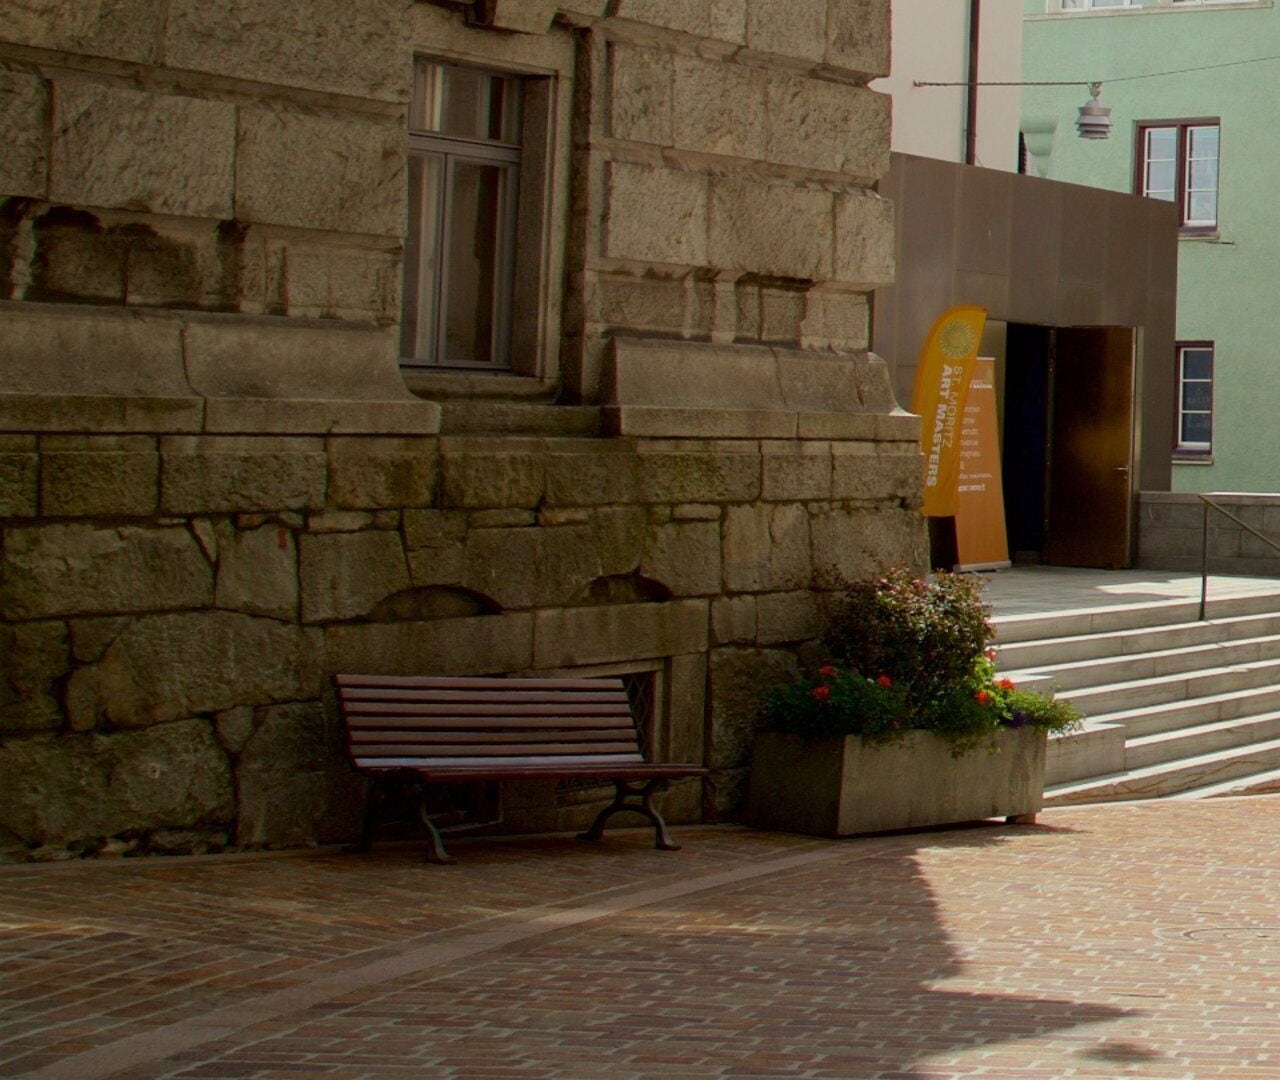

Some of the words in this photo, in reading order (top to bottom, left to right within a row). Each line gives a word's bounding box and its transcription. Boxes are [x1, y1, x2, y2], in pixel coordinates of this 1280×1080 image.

[939, 364, 953, 399] ART
[926, 403, 947, 487] MASTERS
[942, 391, 959, 448] MORITZ
